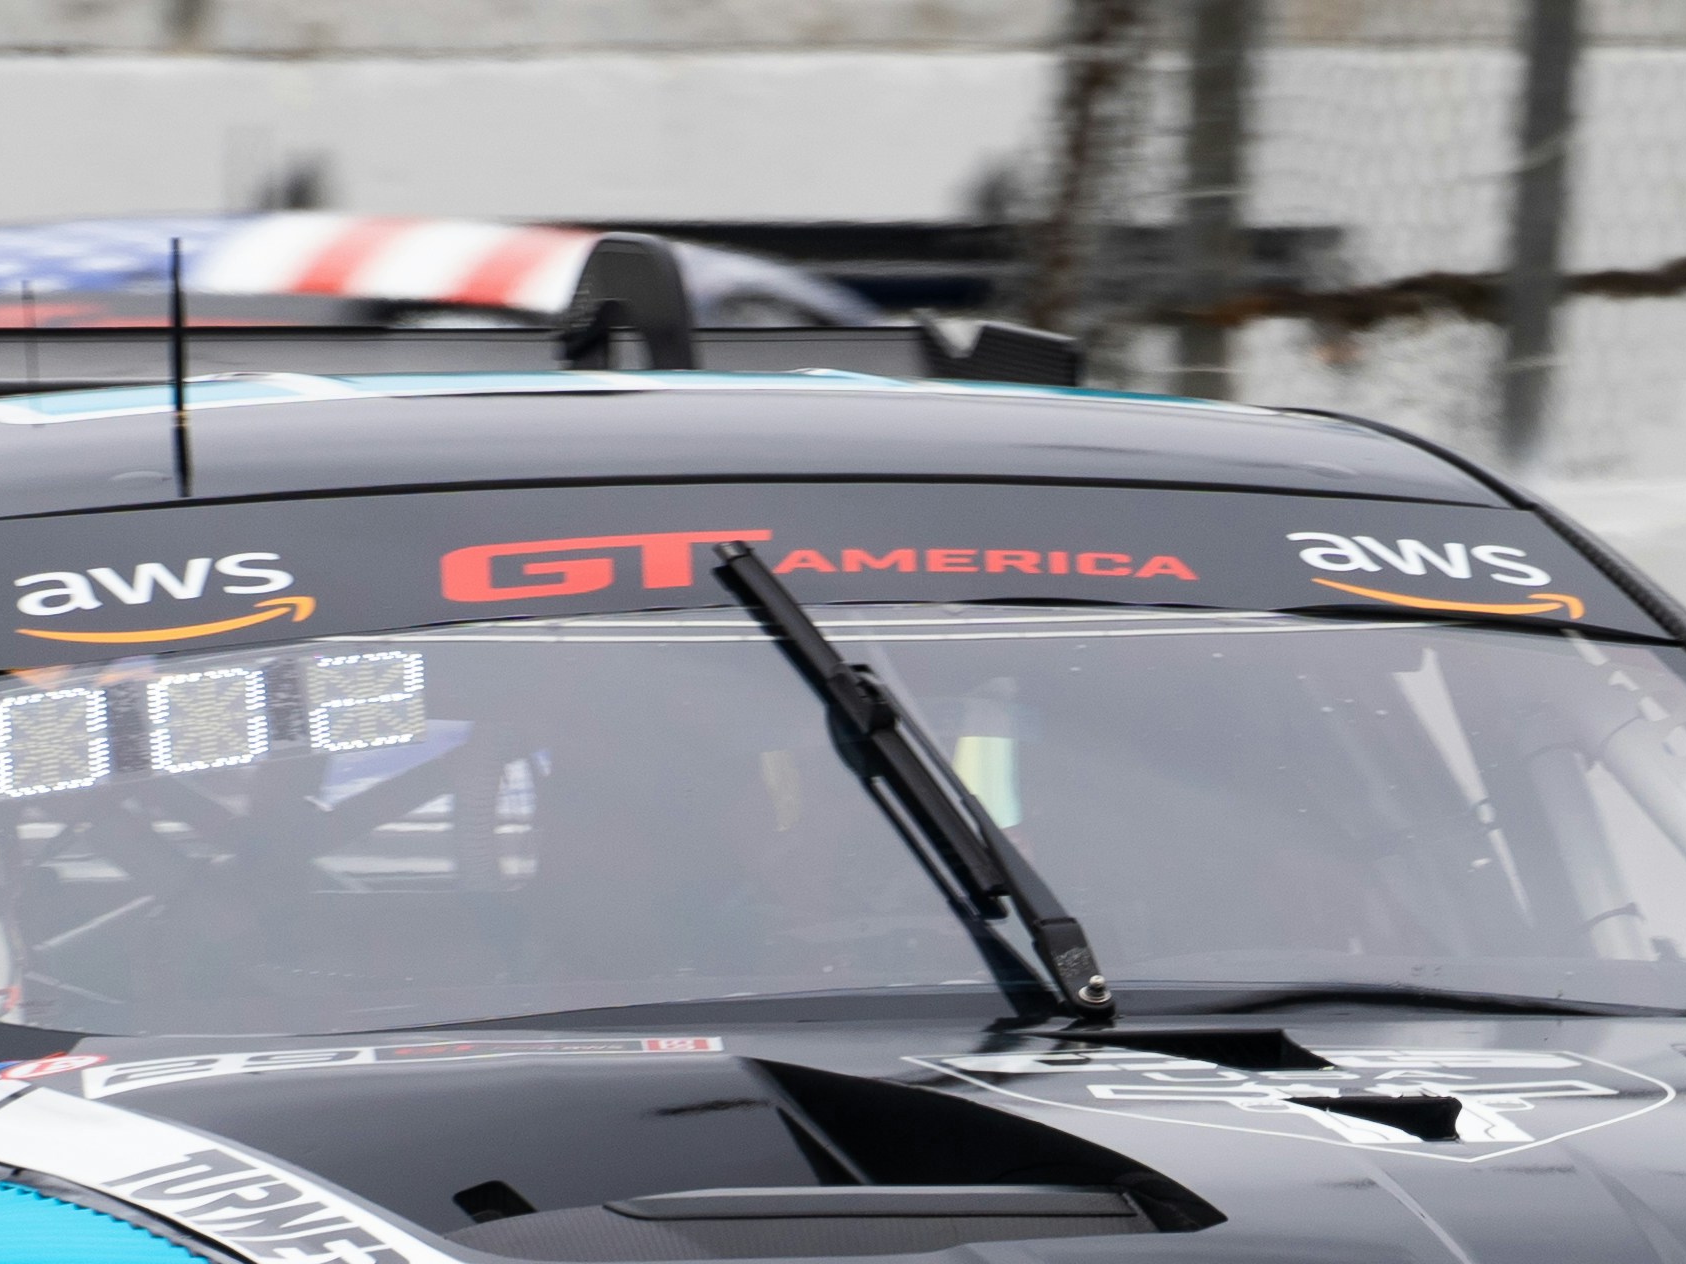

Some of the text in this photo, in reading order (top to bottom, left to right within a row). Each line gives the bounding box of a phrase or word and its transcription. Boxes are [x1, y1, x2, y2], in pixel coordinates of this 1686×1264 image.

[14, 552, 295, 617] aws
[440, 529, 1199, 602] GT AMERICA
[1285, 532, 1552, 587] aws
